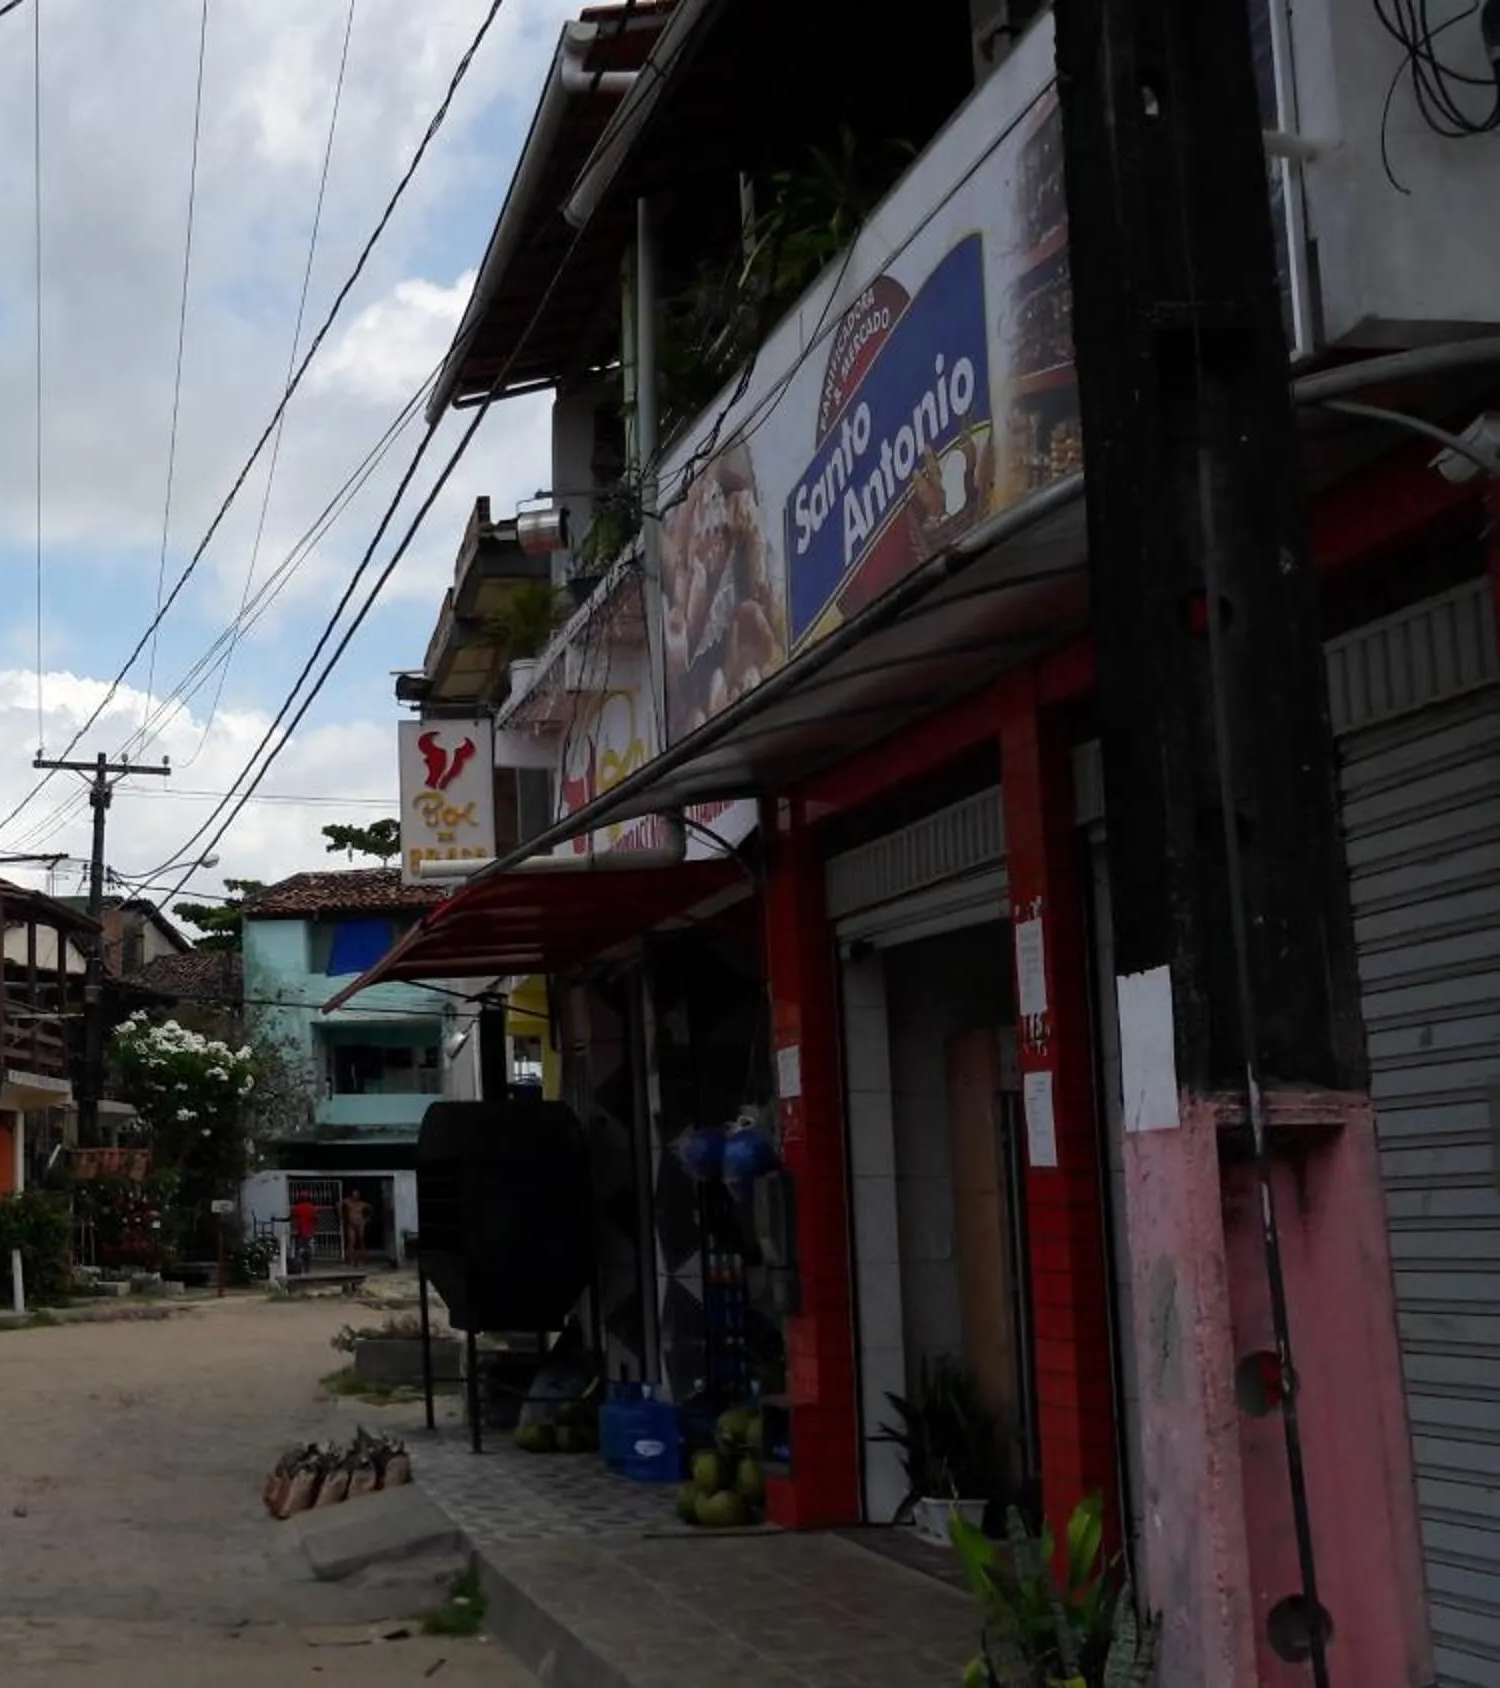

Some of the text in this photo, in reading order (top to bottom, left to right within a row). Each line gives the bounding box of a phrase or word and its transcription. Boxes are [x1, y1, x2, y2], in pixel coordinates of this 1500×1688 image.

[841, 307, 890, 382] MERCADO
[795, 401, 871, 554] Santo
[843, 352, 975, 566] Antonio
